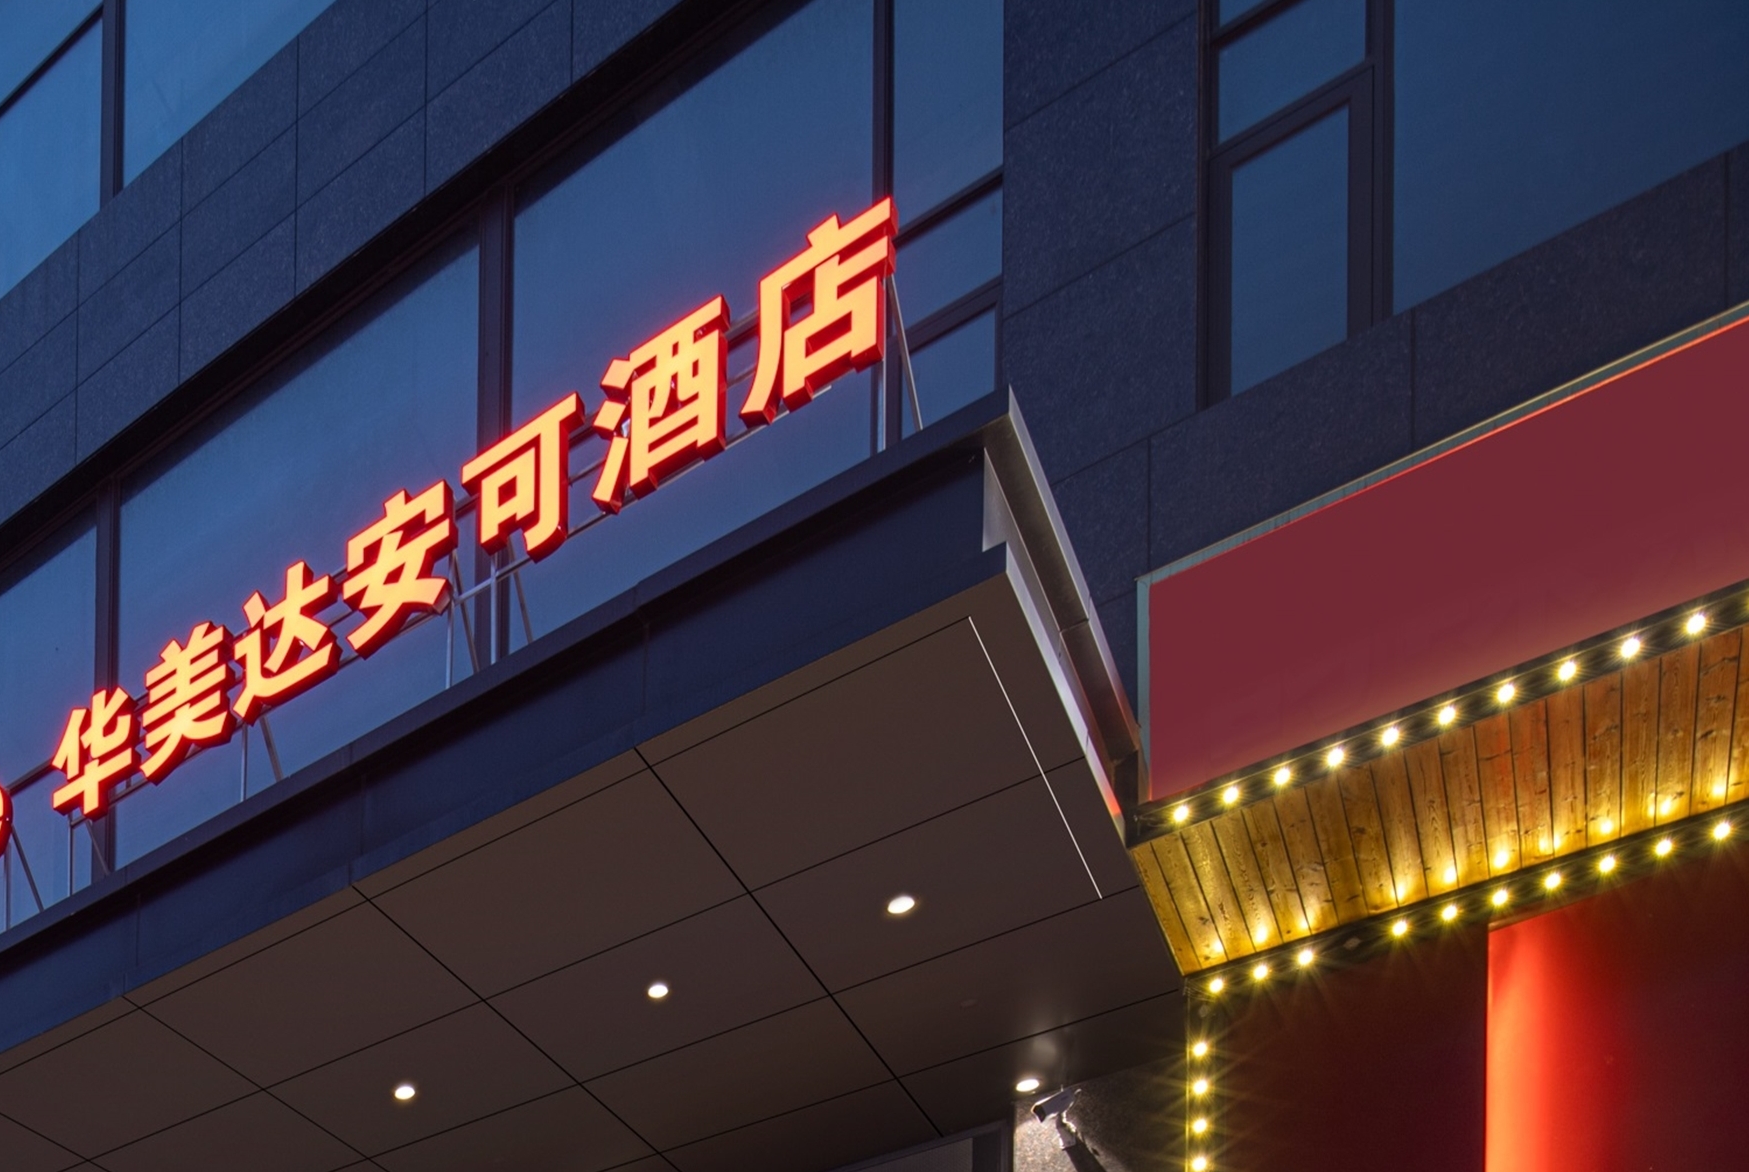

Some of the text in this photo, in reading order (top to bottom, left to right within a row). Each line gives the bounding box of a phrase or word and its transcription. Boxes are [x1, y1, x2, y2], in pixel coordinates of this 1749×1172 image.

[51, 196, 898, 819] 华美达安可酒店
